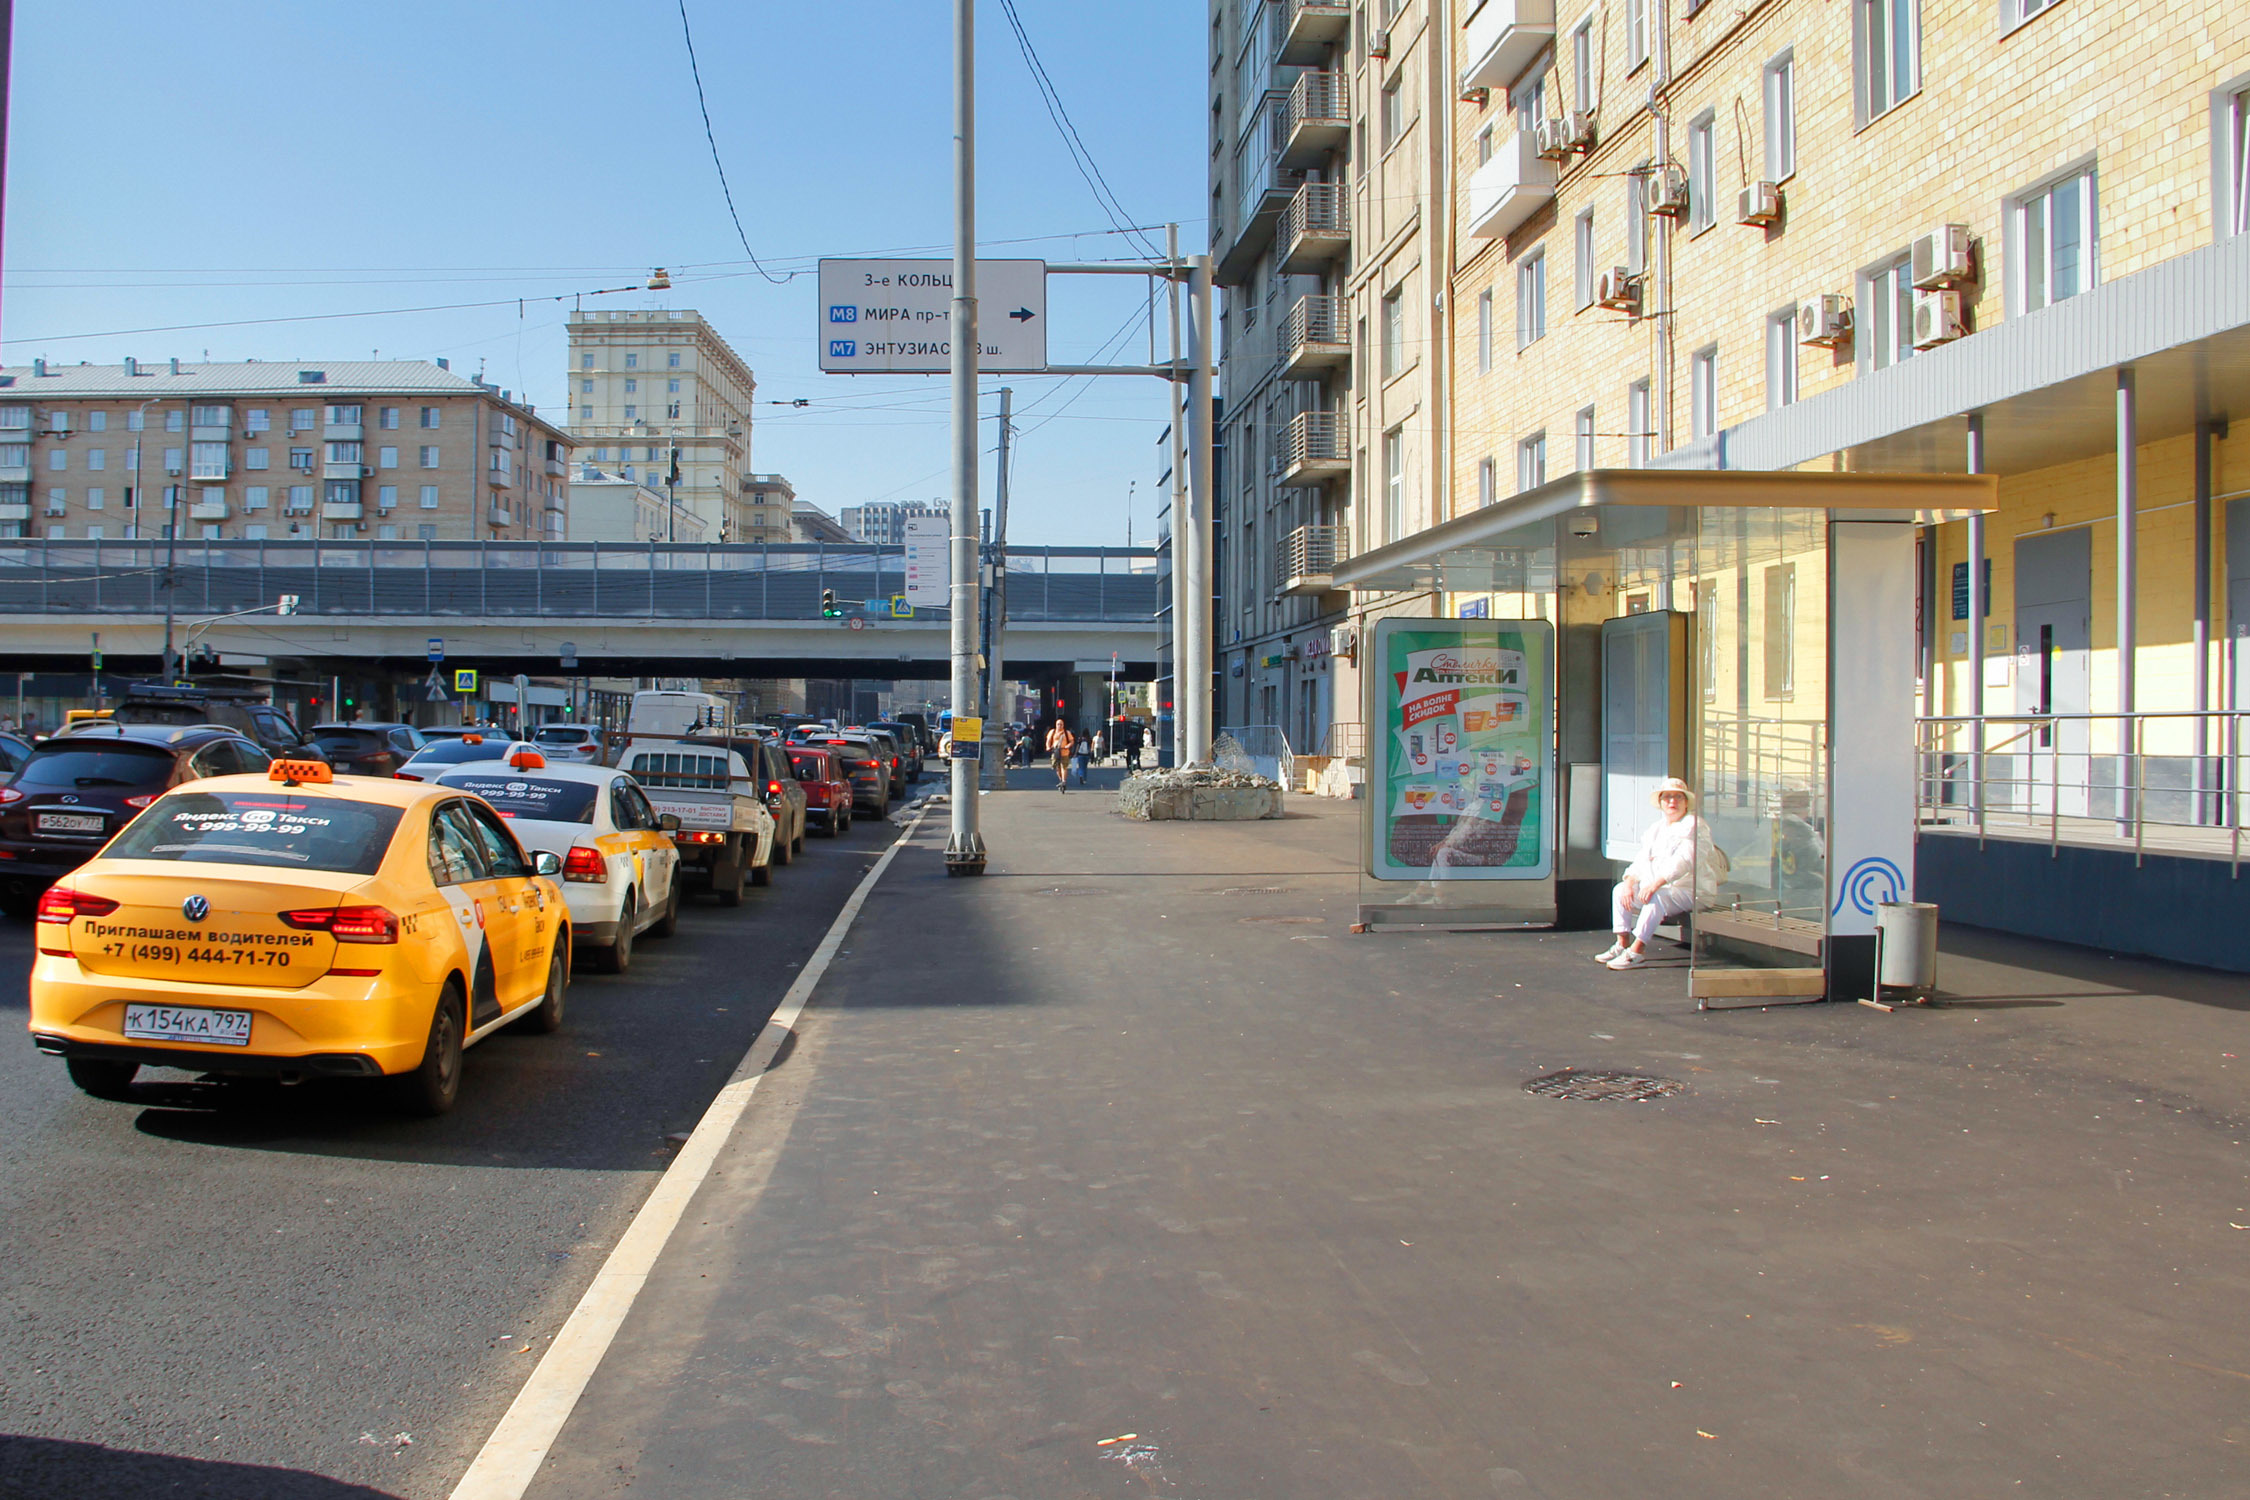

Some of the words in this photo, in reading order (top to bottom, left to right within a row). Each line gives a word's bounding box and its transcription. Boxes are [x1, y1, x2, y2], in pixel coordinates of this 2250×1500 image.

[864, 273, 890, 286] 3-е
[898, 274, 953, 288] КОЛЬЦ
[865, 308, 910, 321] МИРА
[916, 311, 949, 324] пр-т
[865, 342, 982, 355] ЭНТУЗИАСВ
[986, 346, 1002, 355] ш.
[1408, 703, 1422, 714] НА
[1423, 693, 1453, 707] ВОЛНЕ
[1408, 704, 1446, 722] СКИДОК
[463, 781, 505, 790] Яндекс
[529, 784, 562, 794] Такси
[480, 789, 547, 800] 999-99-99
[173, 812, 239, 822] Яндекс
[279, 813, 331, 826] Такси
[197, 821, 306, 834] 999-99-99
[85, 921, 201, 942] Приглашаем
[208, 932, 314, 947] водителей
[103, 943, 124, 957] +7
[131, 944, 181, 965] (499)
[187, 947, 290, 967] 444-71-70
